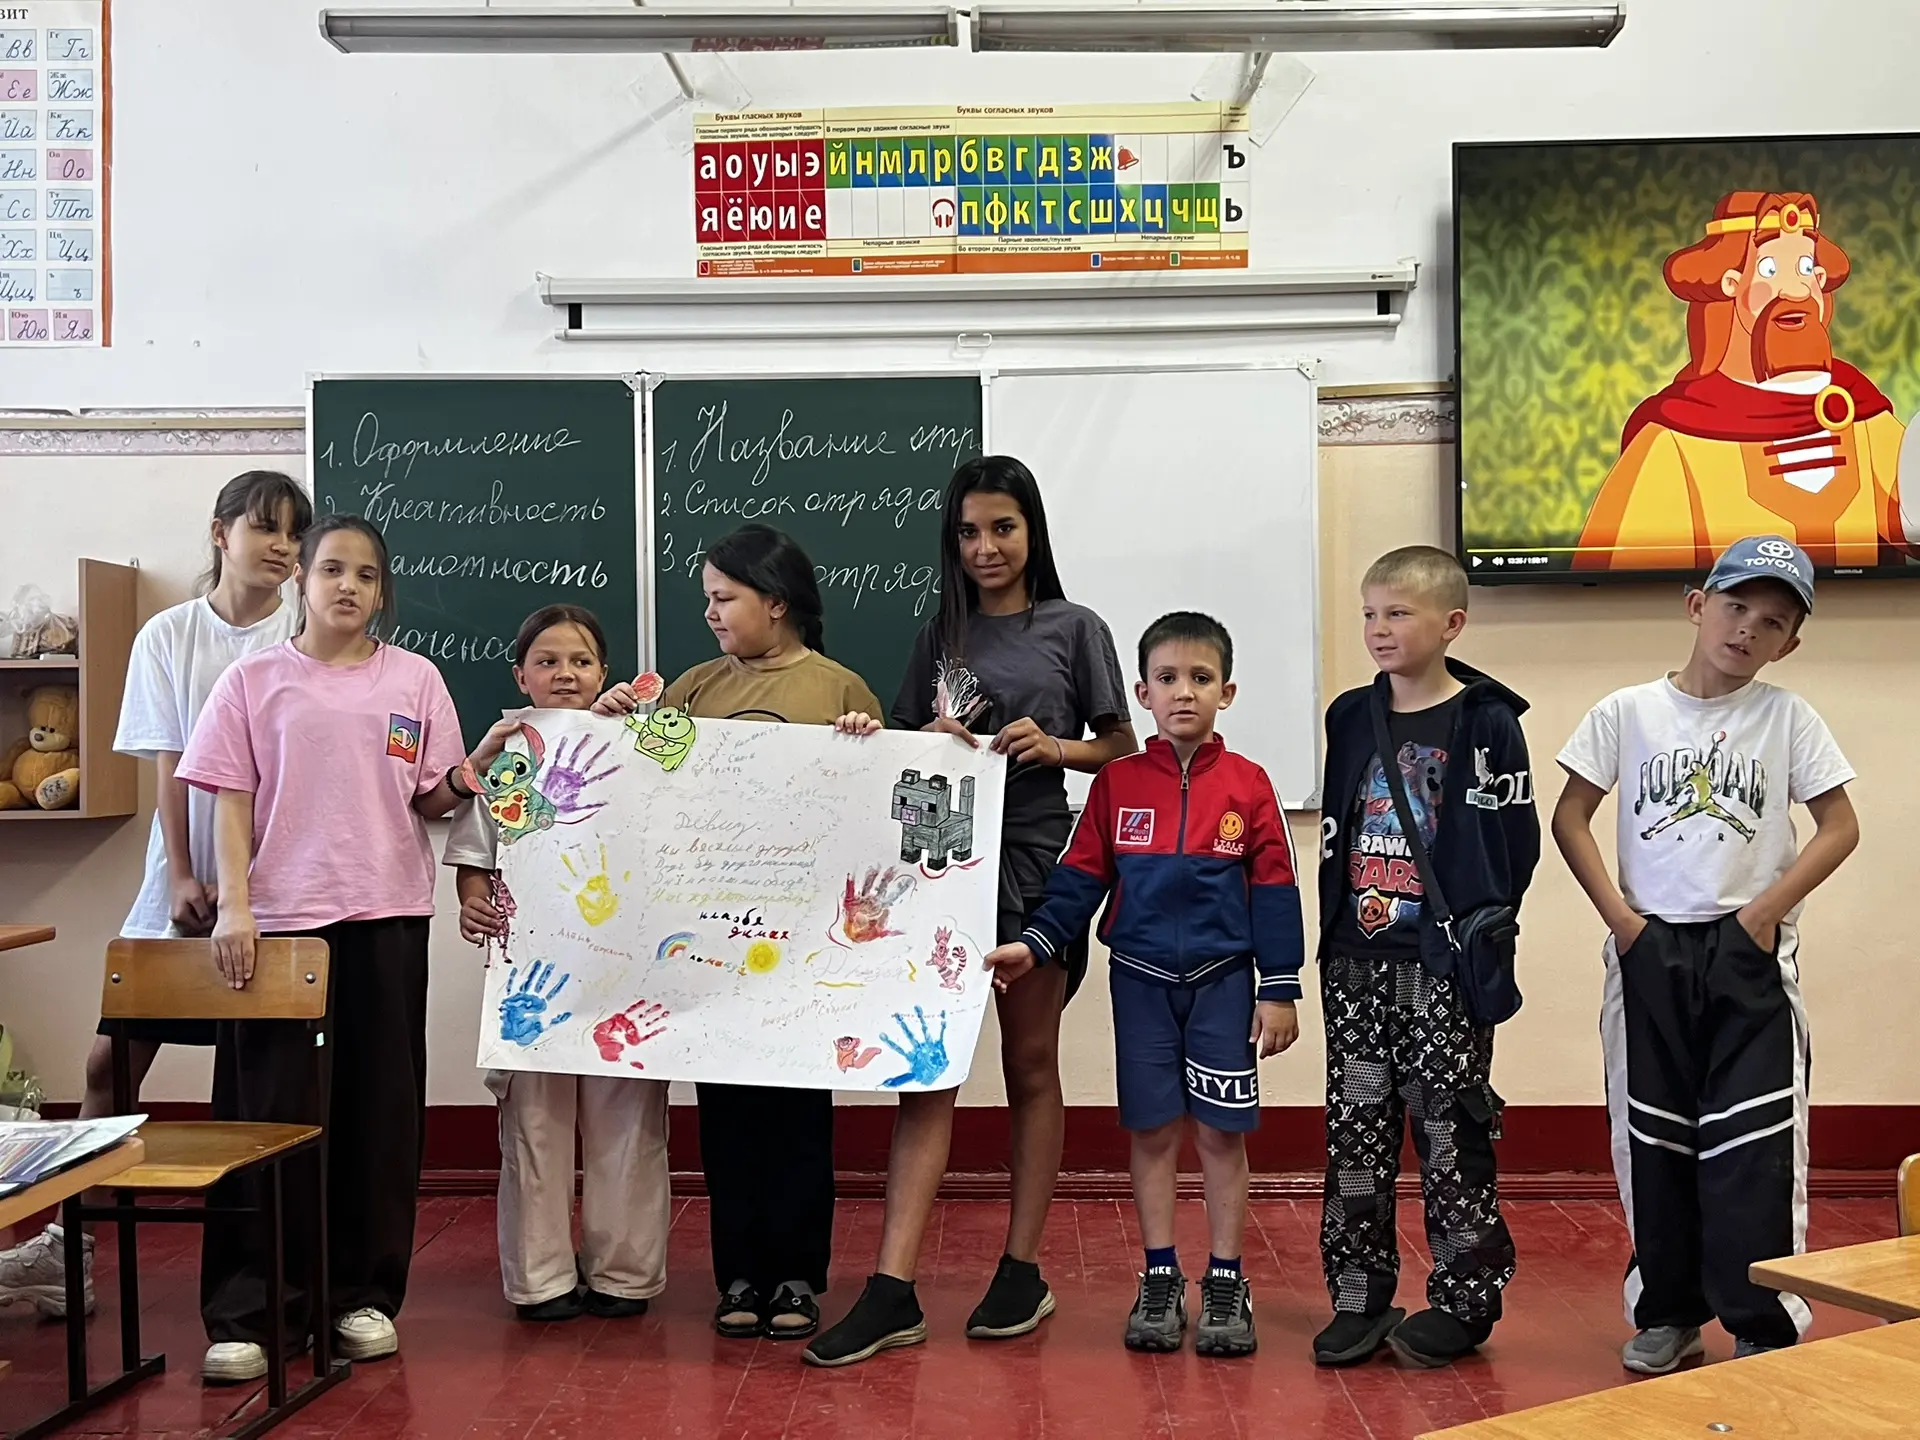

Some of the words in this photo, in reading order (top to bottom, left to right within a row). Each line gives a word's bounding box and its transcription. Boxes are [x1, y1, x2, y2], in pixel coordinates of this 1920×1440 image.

[6, 40, 33, 58] Вв
[62, 38, 89, 58] Гг
[8, 80, 31, 98] Ее
[49, 80, 92, 98] Жж
[715, 113, 740, 122] Буквы
[776, 112, 802, 120] звуков
[957, 106, 982, 115] Буквы
[56, 119, 92, 138] Кк
[2, 160, 36, 178] Нн
[63, 159, 84, 178] Оо
[7, 200, 30, 218] Сс
[47, 199, 92, 218] Тт
[2, 240, 33, 258] Хх
[59, 240, 88, 261] Цц
[17, 320, 47, 339] Юю
[61, 320, 92, 339] Яя
[321, 441, 342, 468] 1.
[353, 412, 581, 478] Оформление
[661, 440, 677, 473] 1.
[690, 400, 896, 486] Название
[910, 423, 982, 469] отр
[360, 480, 605, 535] Креативность
[661, 492, 677, 517] 2.
[685, 480, 796, 518] Список
[804, 488, 943, 528] отряда
[391, 554, 608, 588] амотность
[1744, 558, 1800, 578] TOYOTA
[1358, 834, 1412, 857] RAW
[1349, 850, 1424, 896] SARS
[1185, 1066, 1258, 1100] STYLE
[1149, 1266, 1172, 1275] NIKE
[1212, 1268, 1236, 1279] NIKE
